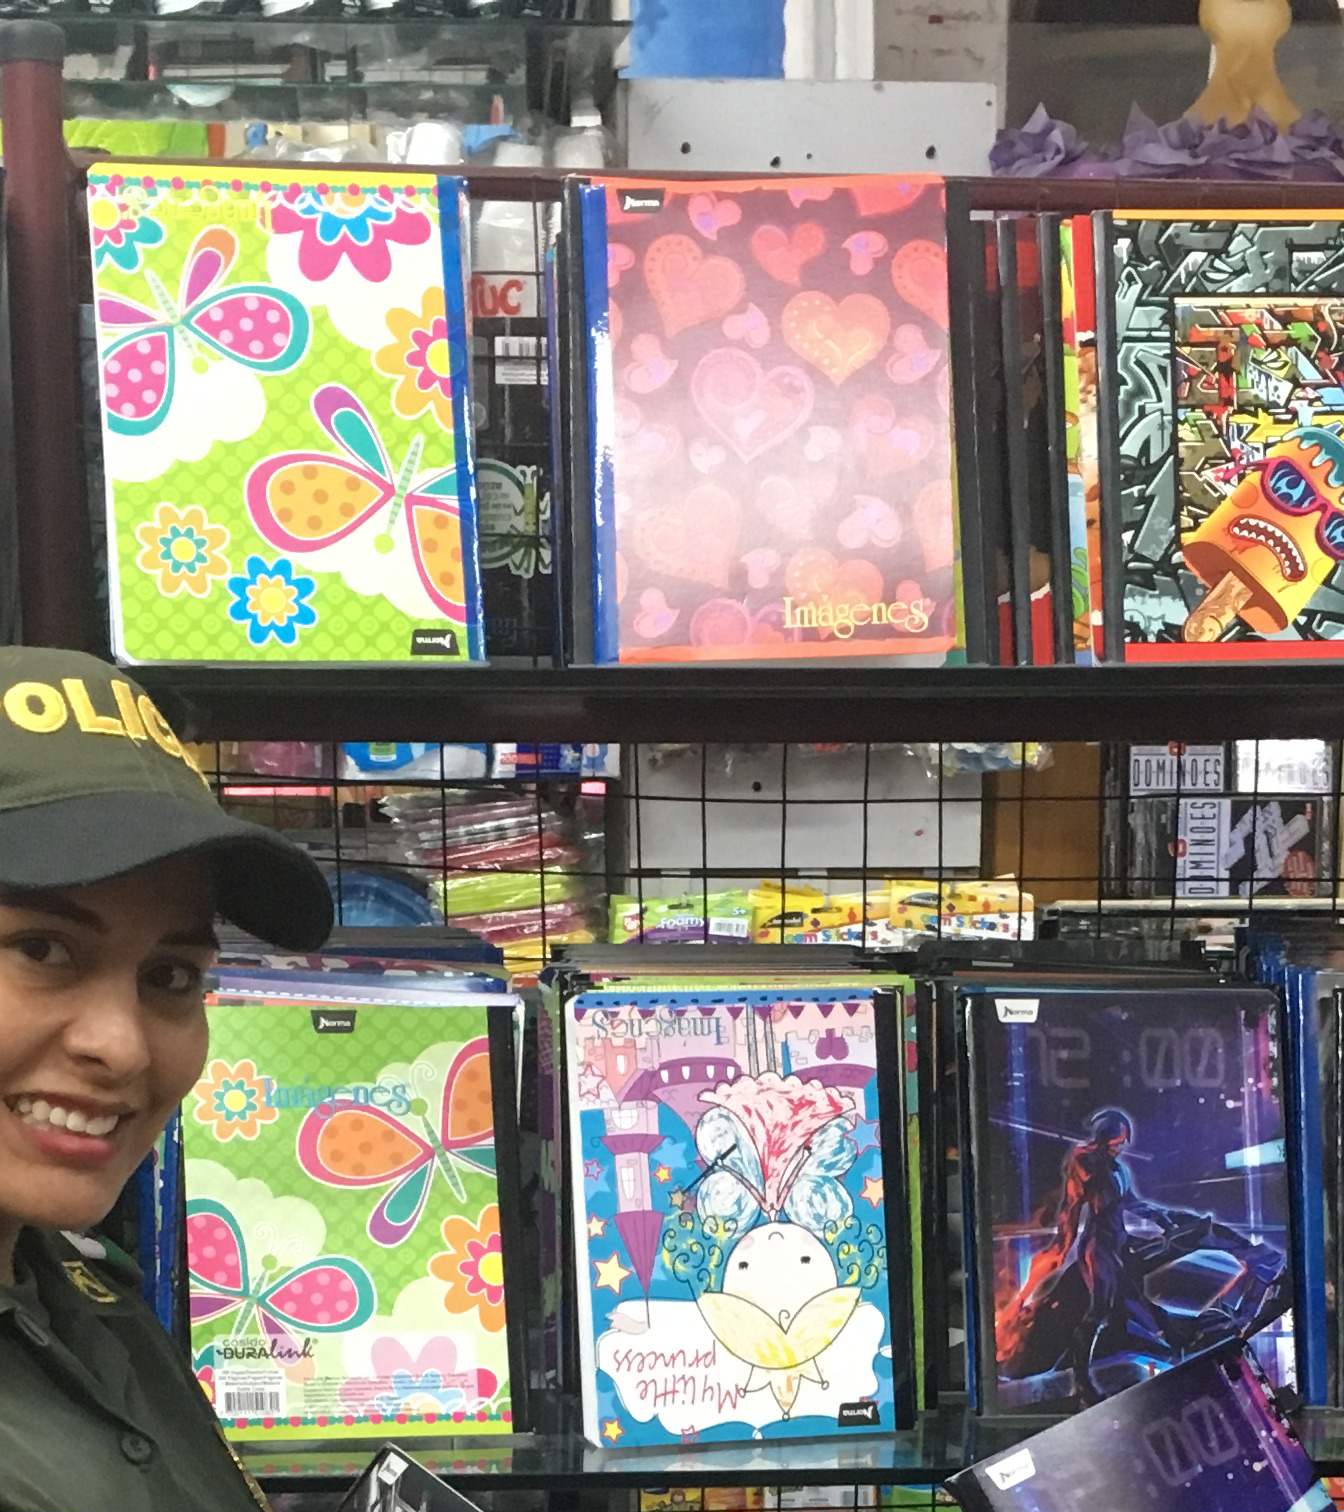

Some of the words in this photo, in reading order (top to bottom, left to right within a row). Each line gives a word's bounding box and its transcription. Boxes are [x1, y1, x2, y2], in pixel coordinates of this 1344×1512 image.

[782, 596, 929, 639] Imágenes
[1132, 757, 1222, 788] DOMINOES
[1187, 801, 1217, 896] DOMINOES
[318, 1016, 351, 1030] Norma
[264, 1075, 411, 1120] Imágenes
[222, 1337, 266, 1347] cosido
[612, 1339, 717, 1373] princess
